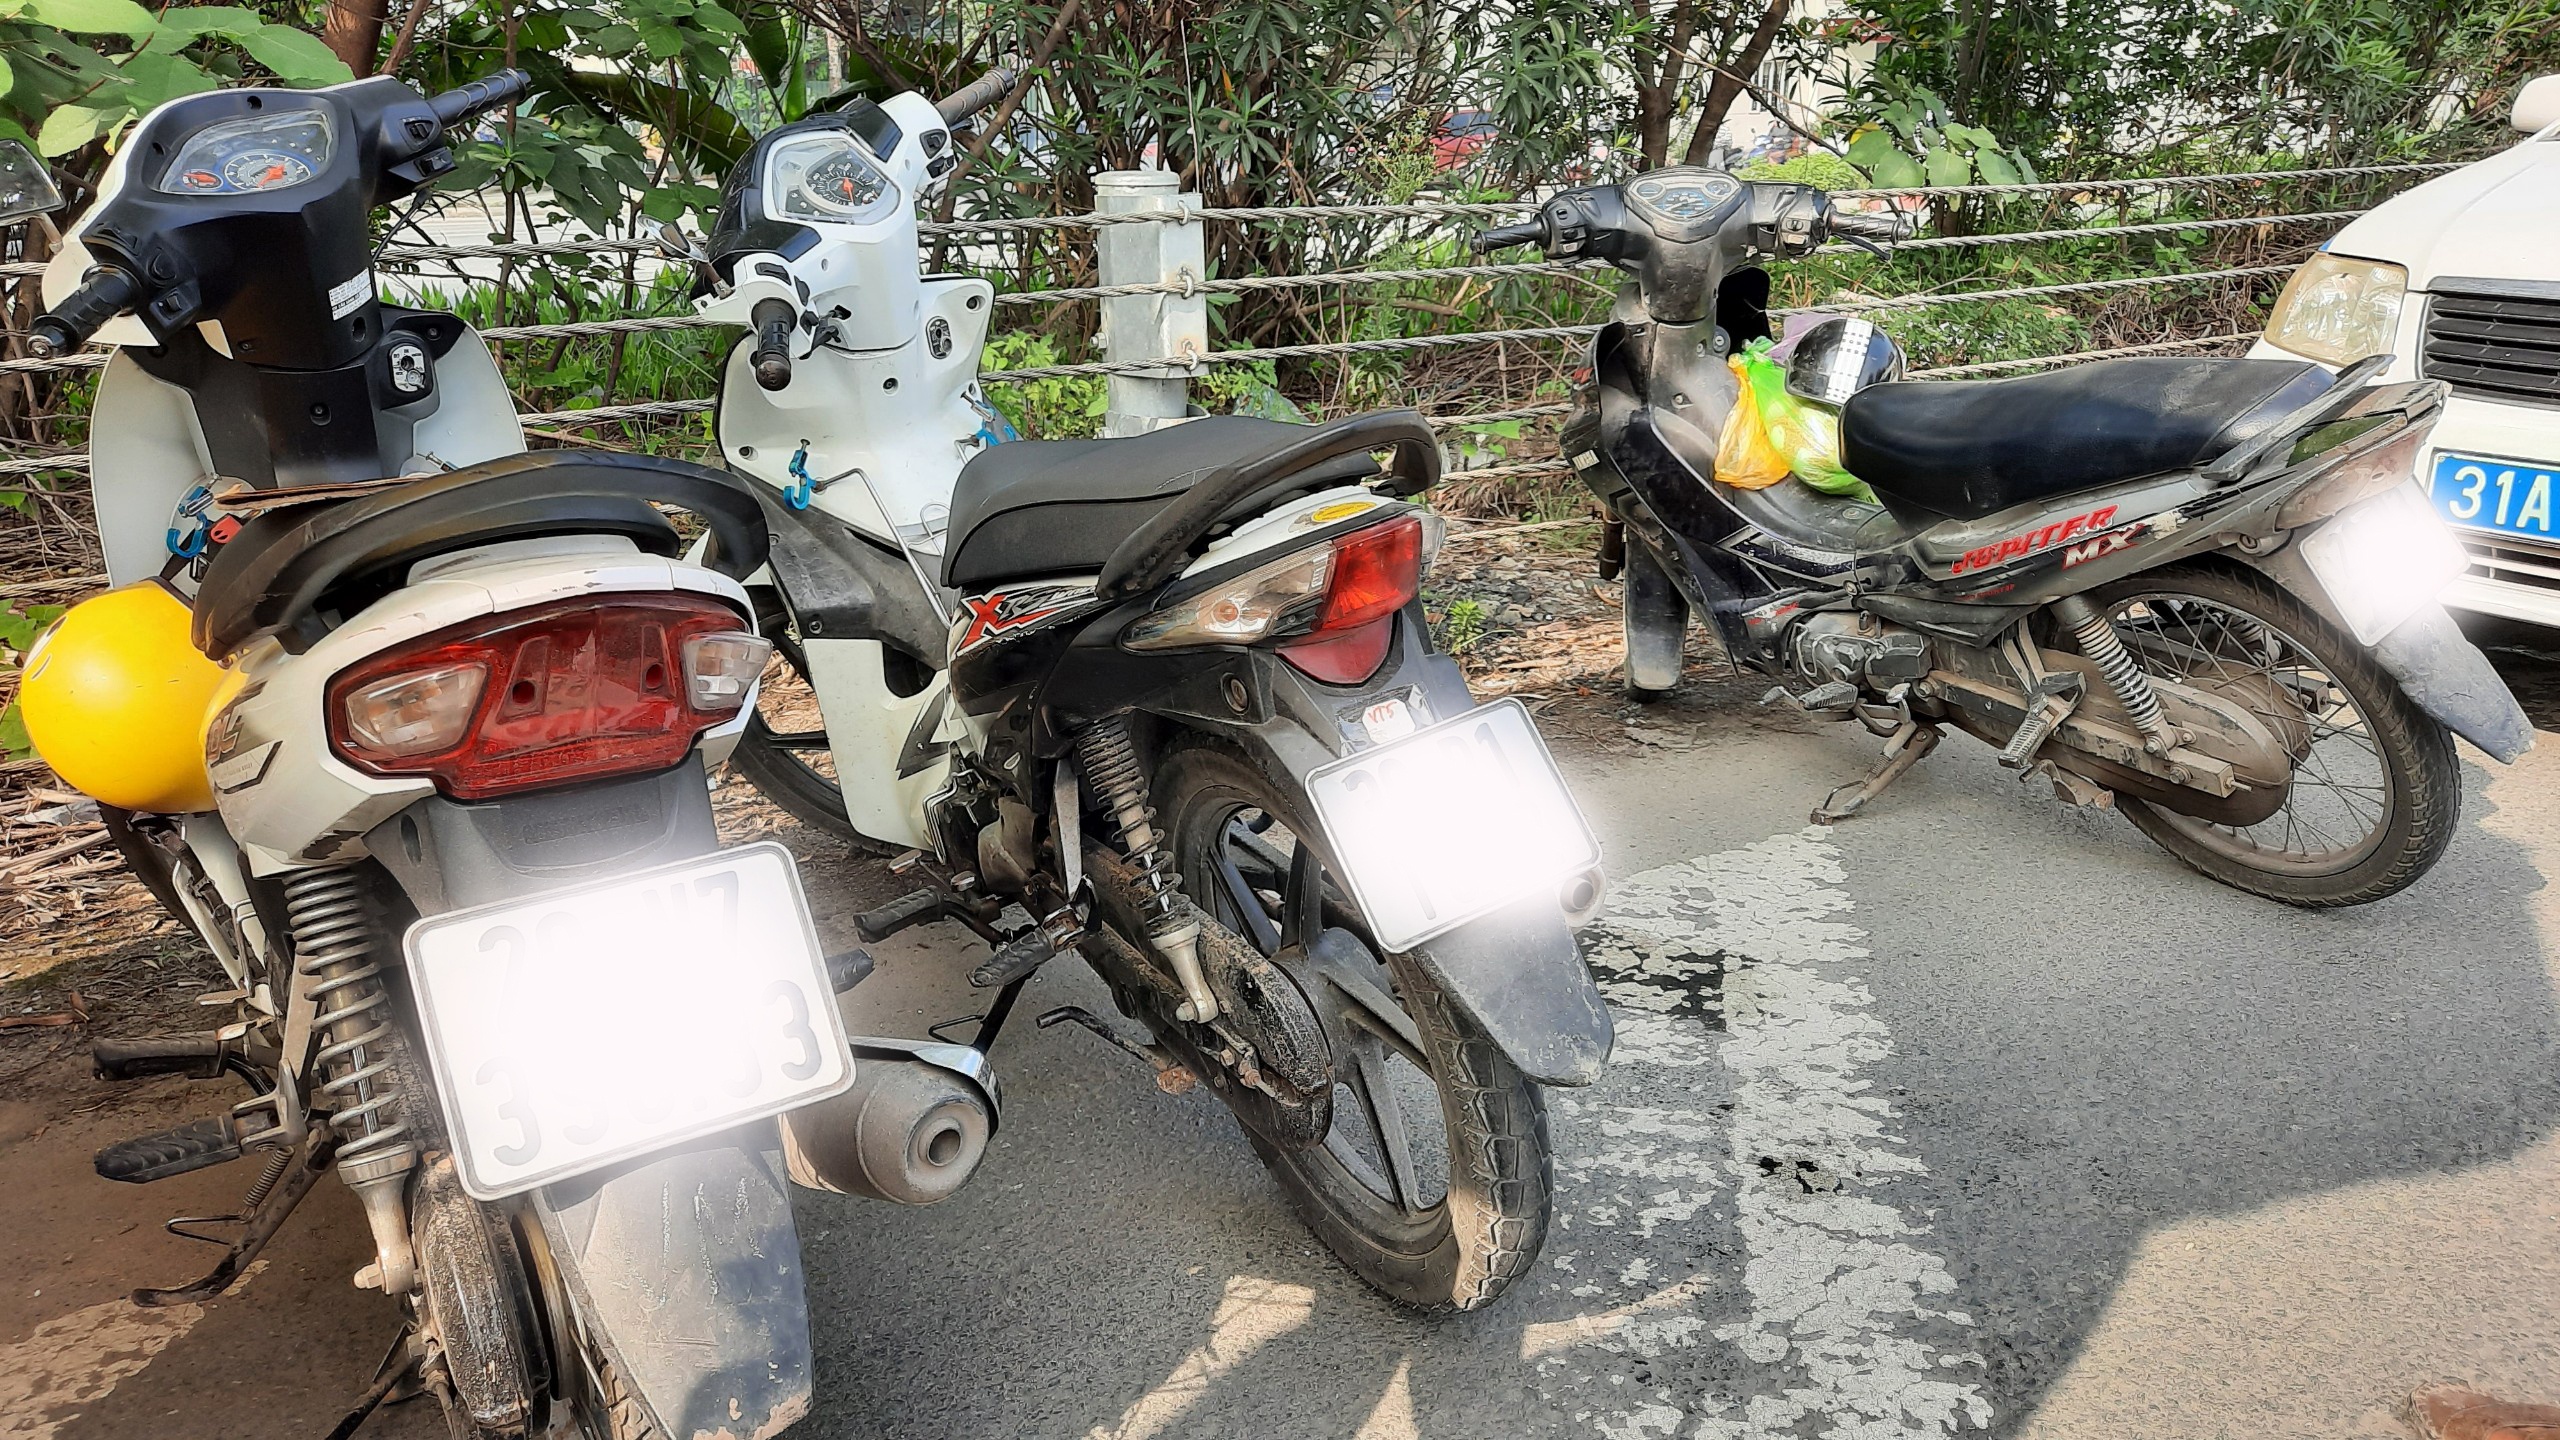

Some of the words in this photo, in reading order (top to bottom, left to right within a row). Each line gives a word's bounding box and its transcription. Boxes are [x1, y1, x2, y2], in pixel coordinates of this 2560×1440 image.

[2448, 465, 2551, 532] 31A
[1951, 504, 2119, 574] JUPITER
[2062, 523, 2147, 571] MX
